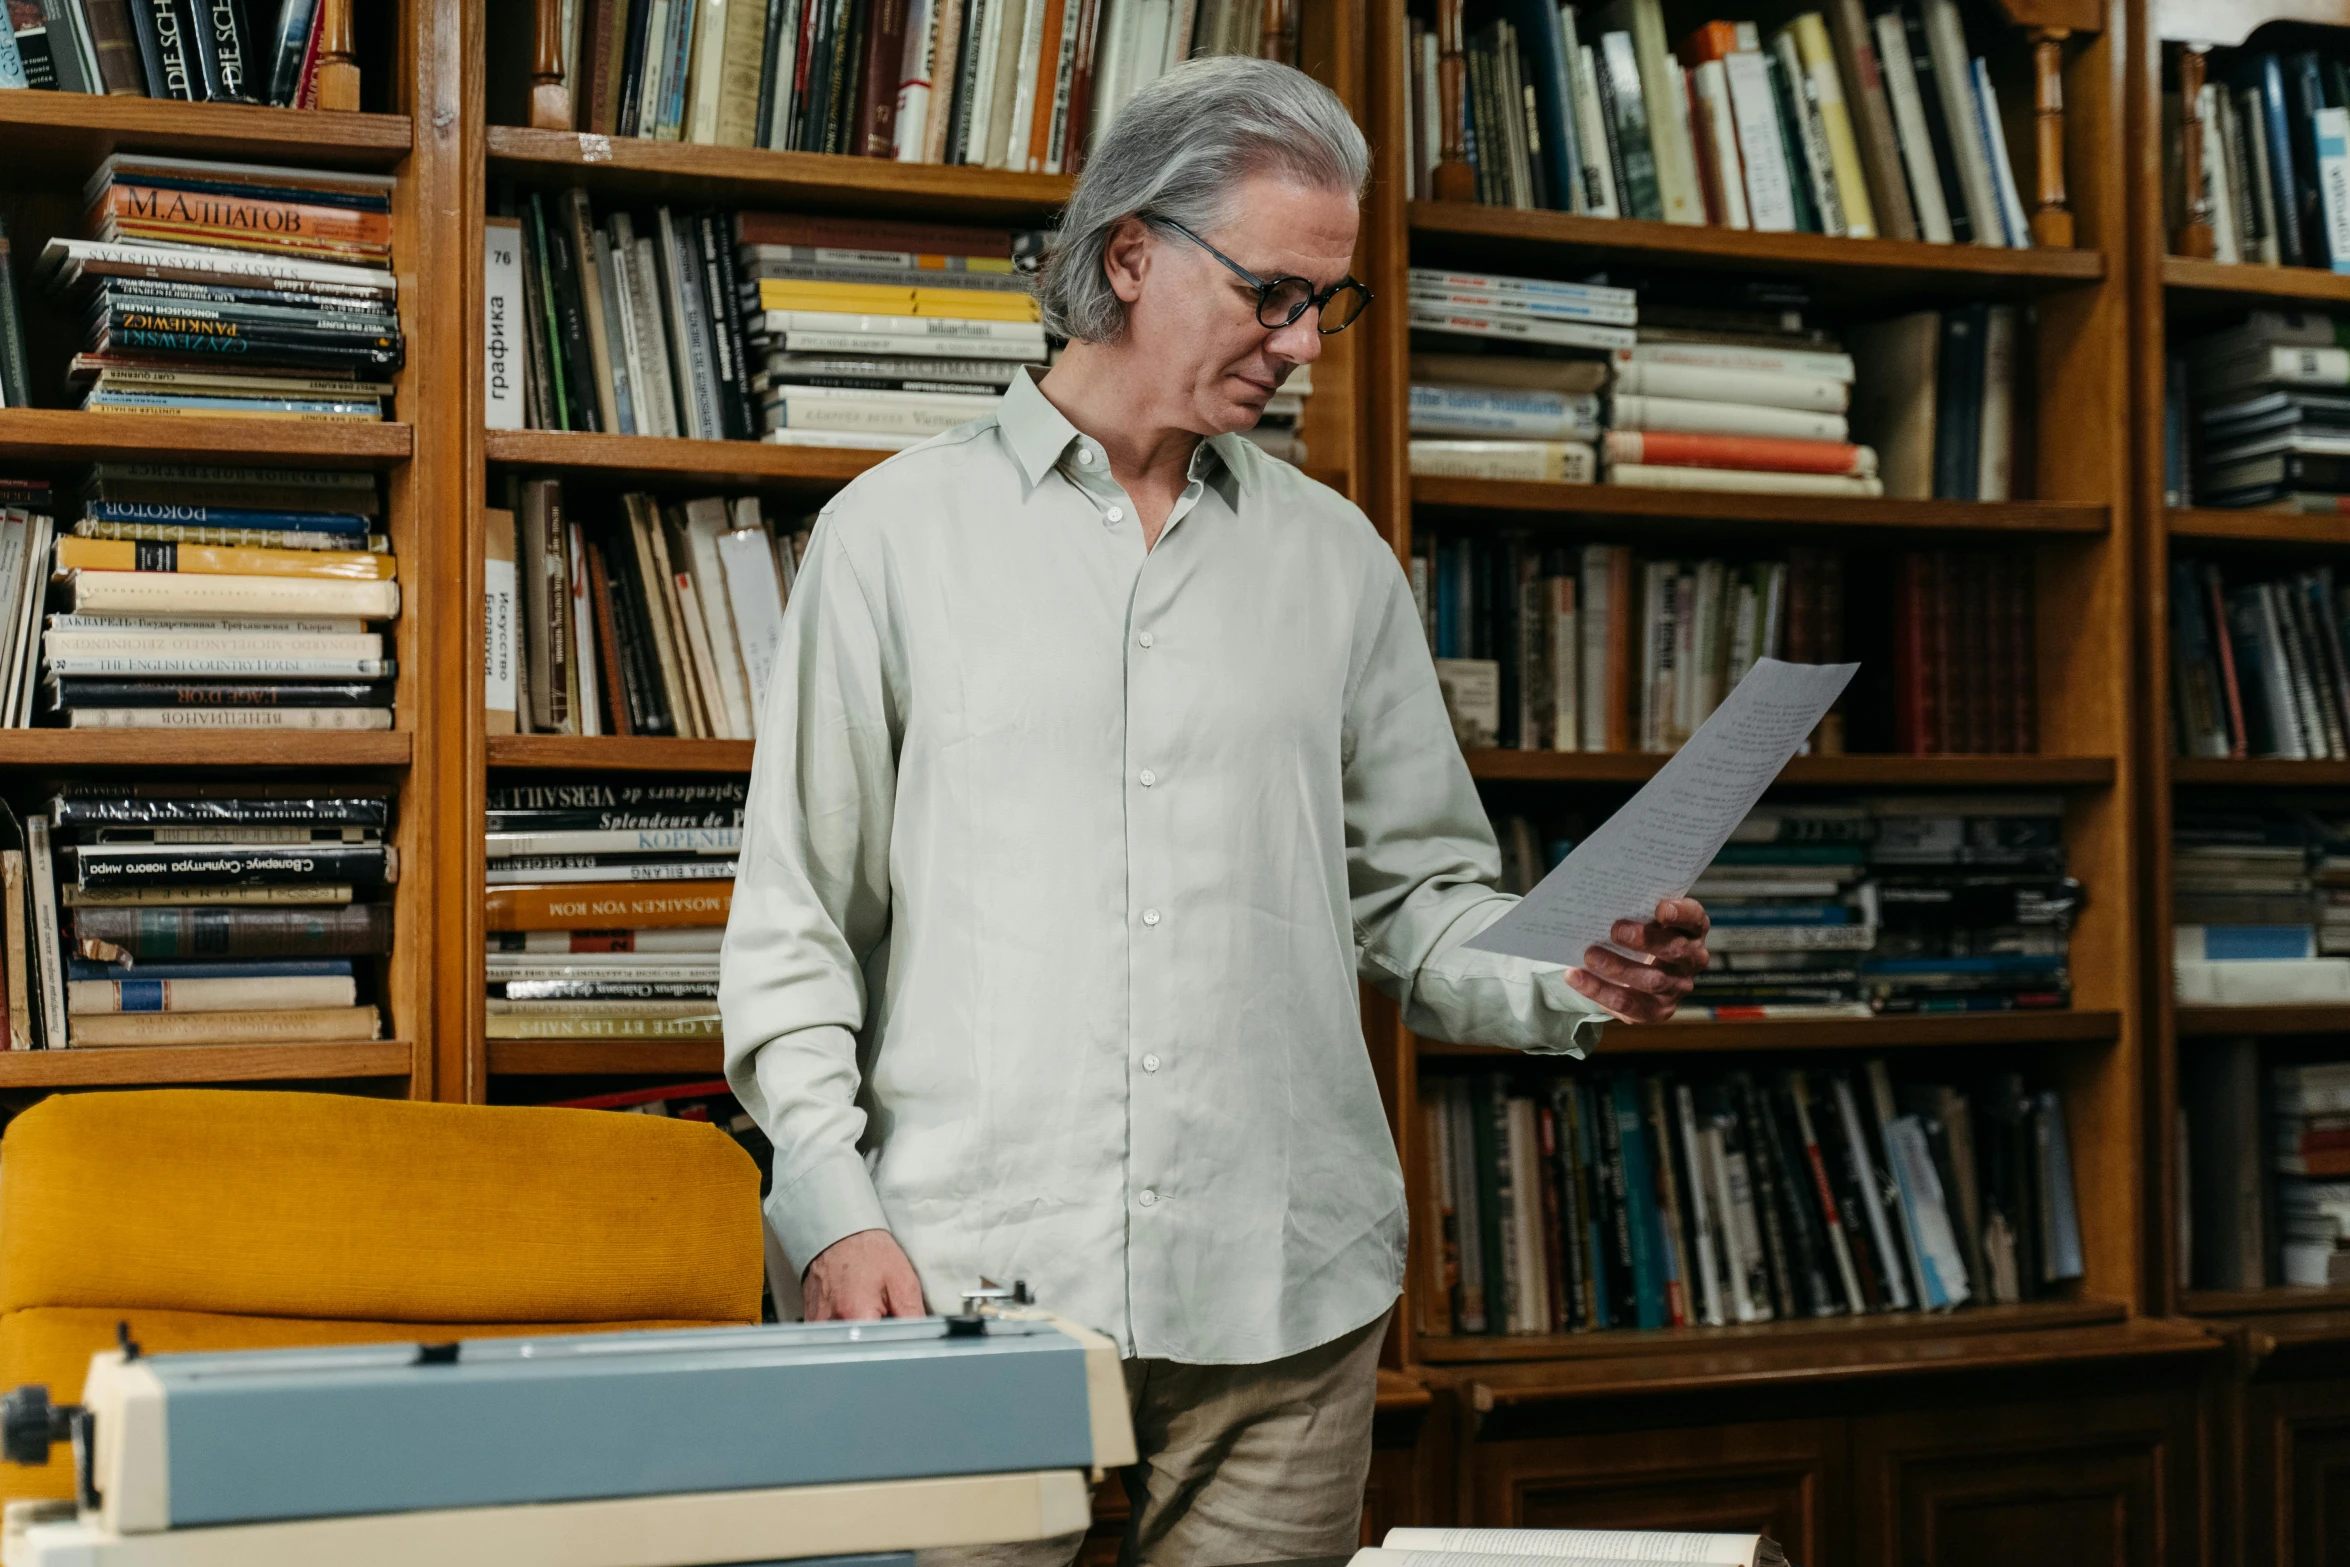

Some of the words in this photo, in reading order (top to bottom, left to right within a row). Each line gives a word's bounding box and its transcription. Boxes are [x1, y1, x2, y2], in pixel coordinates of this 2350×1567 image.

[163, 53, 187, 90] DIE
[219, 47, 243, 86] DIE
[89, 250, 215, 272] KRASAUSKAS
[493, 249, 512, 266] 76
[230, 261, 299, 280] STASYS
[116, 303, 153, 314] MALEREI
[156, 306, 219, 319] MONGOLISCHE
[123, 314, 237, 337] PANKIEWICZ
[317, 320, 345, 330] KUNST
[346, 322, 362, 331] DER
[364, 323, 386, 333] WELT
[487, 295, 510, 401] графика
[110, 370, 151, 380] QUERNER
[153, 372, 175, 381] CURT
[106, 502, 207, 523] РОКОТОВ
[66, 615, 131, 627] АКВАРЕЛЬ
[485, 592, 497, 676] Беларуси
[497, 591, 509, 681] Искусство
[61, 638, 165, 652] ZEICHNUNGEN
[98, 659, 122, 671] THE
[127, 657, 187, 671] ENGLISH
[188, 658, 254, 672] COUNTRY
[178, 690, 223, 704] D'OR
[162, 712, 283, 725] ВЕНЕЦИАНОВ
[622, 787, 646, 805] de
[648, 783, 745, 803] Splendeurs
[599, 811, 698, 831] Splendeurs
[703, 811, 724, 828] de
[89, 864, 123, 876] мира
[126, 863, 167, 874] нового
[171, 859, 241, 875] Скульптура
[566, 856, 597, 869] DAS
[631, 867, 684, 879] BILANG
[548, 902, 587, 917] ROM
[591, 901, 629, 915] VON
[631, 897, 721, 914] MOSAIKEN
[580, 1020, 614, 1035] LES
[622, 1020, 645, 1035] ET
